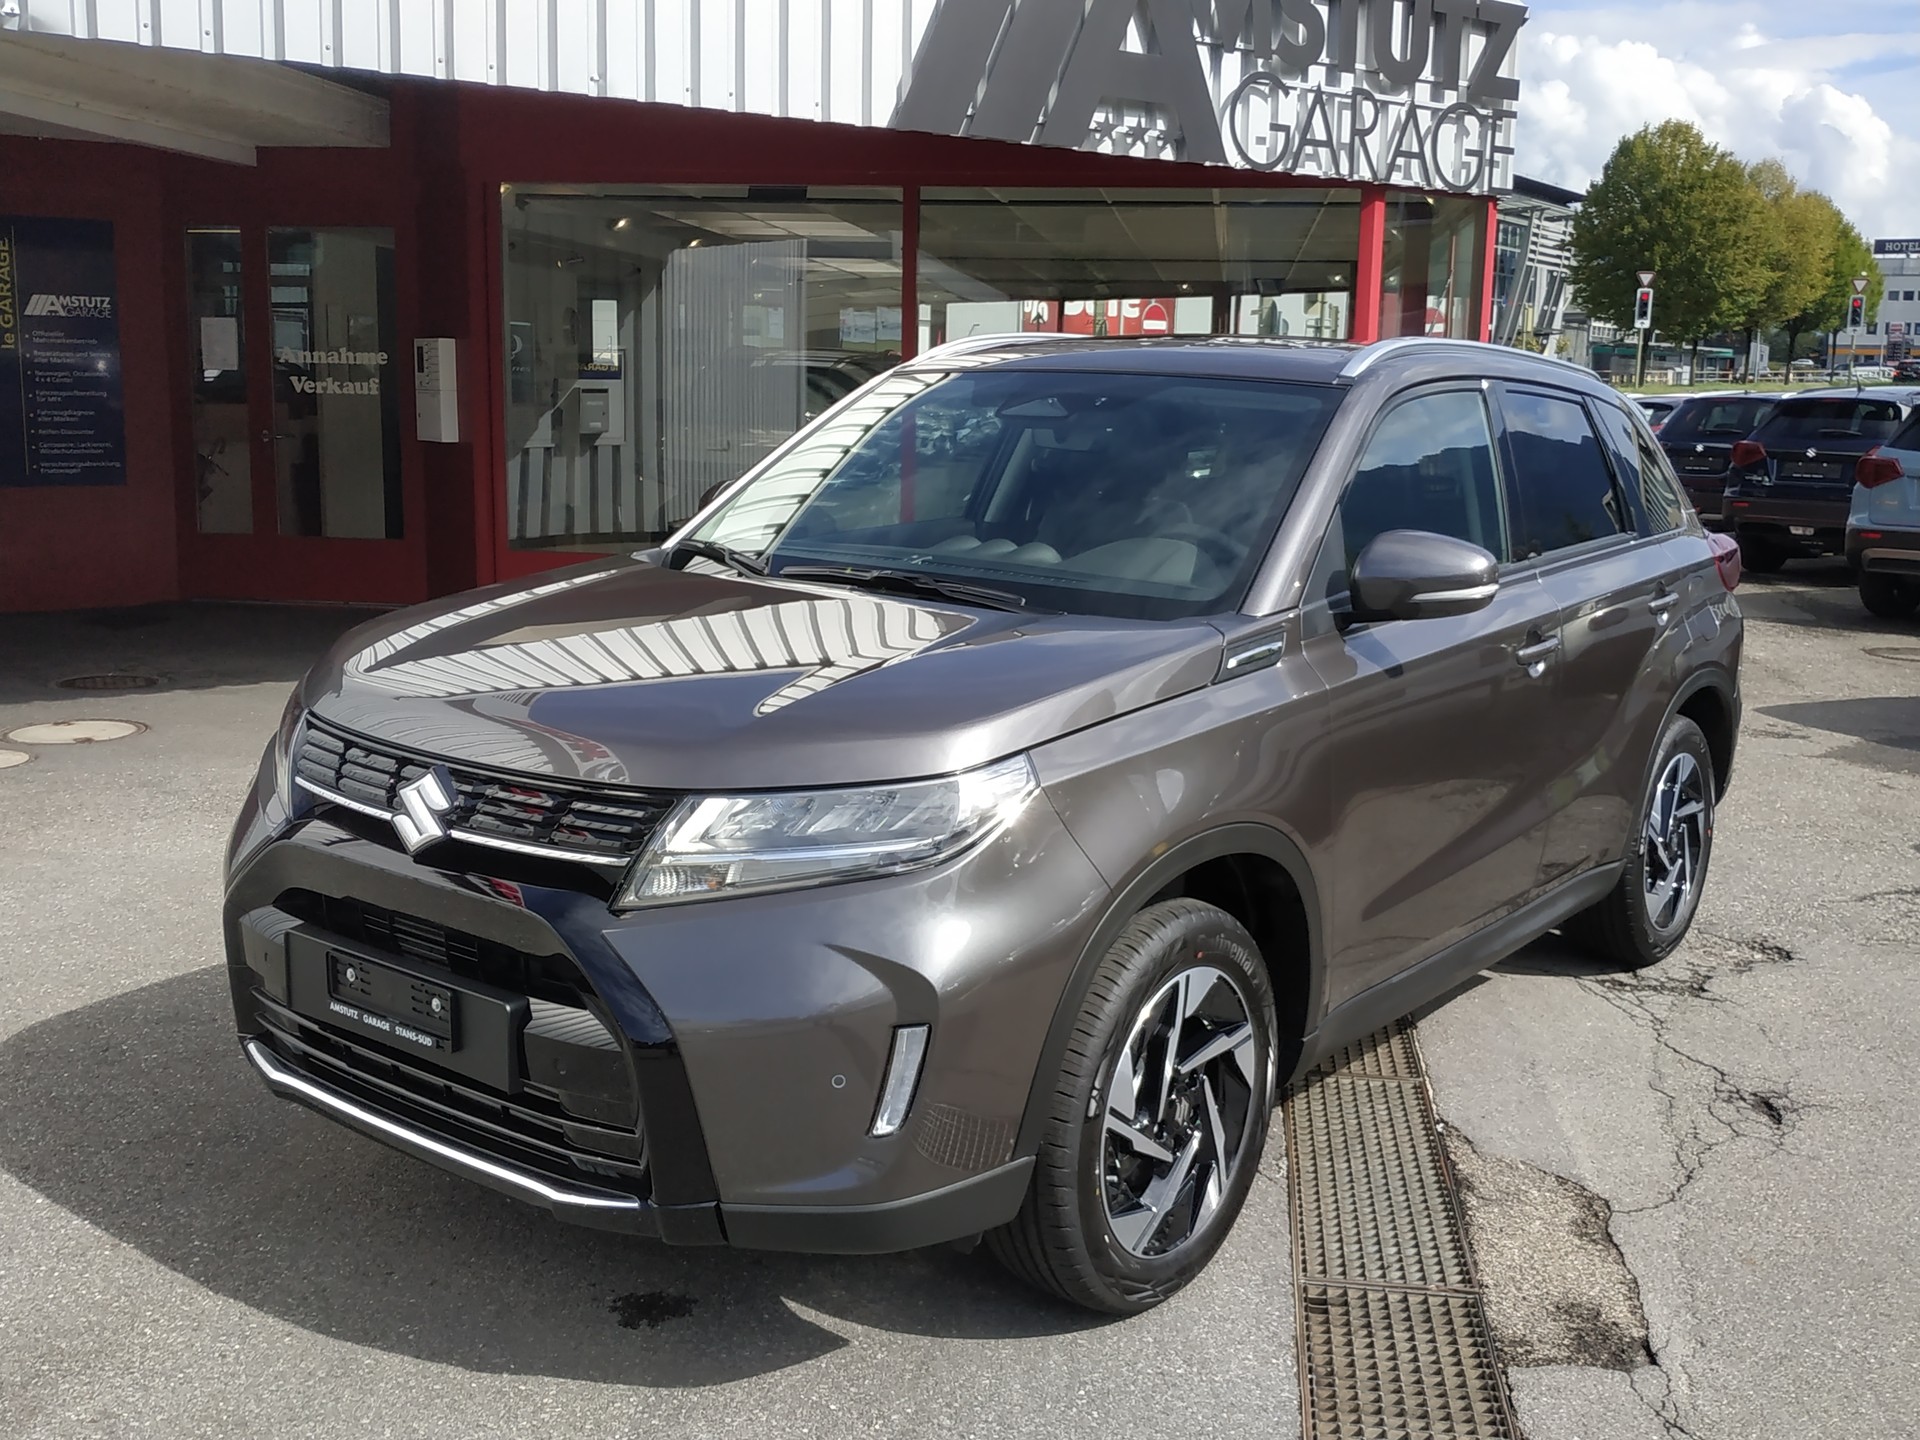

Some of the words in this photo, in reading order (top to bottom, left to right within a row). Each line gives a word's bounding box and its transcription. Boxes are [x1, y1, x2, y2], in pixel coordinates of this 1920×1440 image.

[1229, 71, 1518, 195] GARAGE
[1885, 241, 1920, 252] HOTEL
[40, 294, 111, 316] AMSTUTZ
[65, 307, 111, 318] GARAGE
[279, 346, 388, 365] Annahme
[289, 376, 379, 395] Verkauf
[329, 1001, 359, 1020] AMSTUTZ
[362, 1014, 390, 1032] GARAGE
